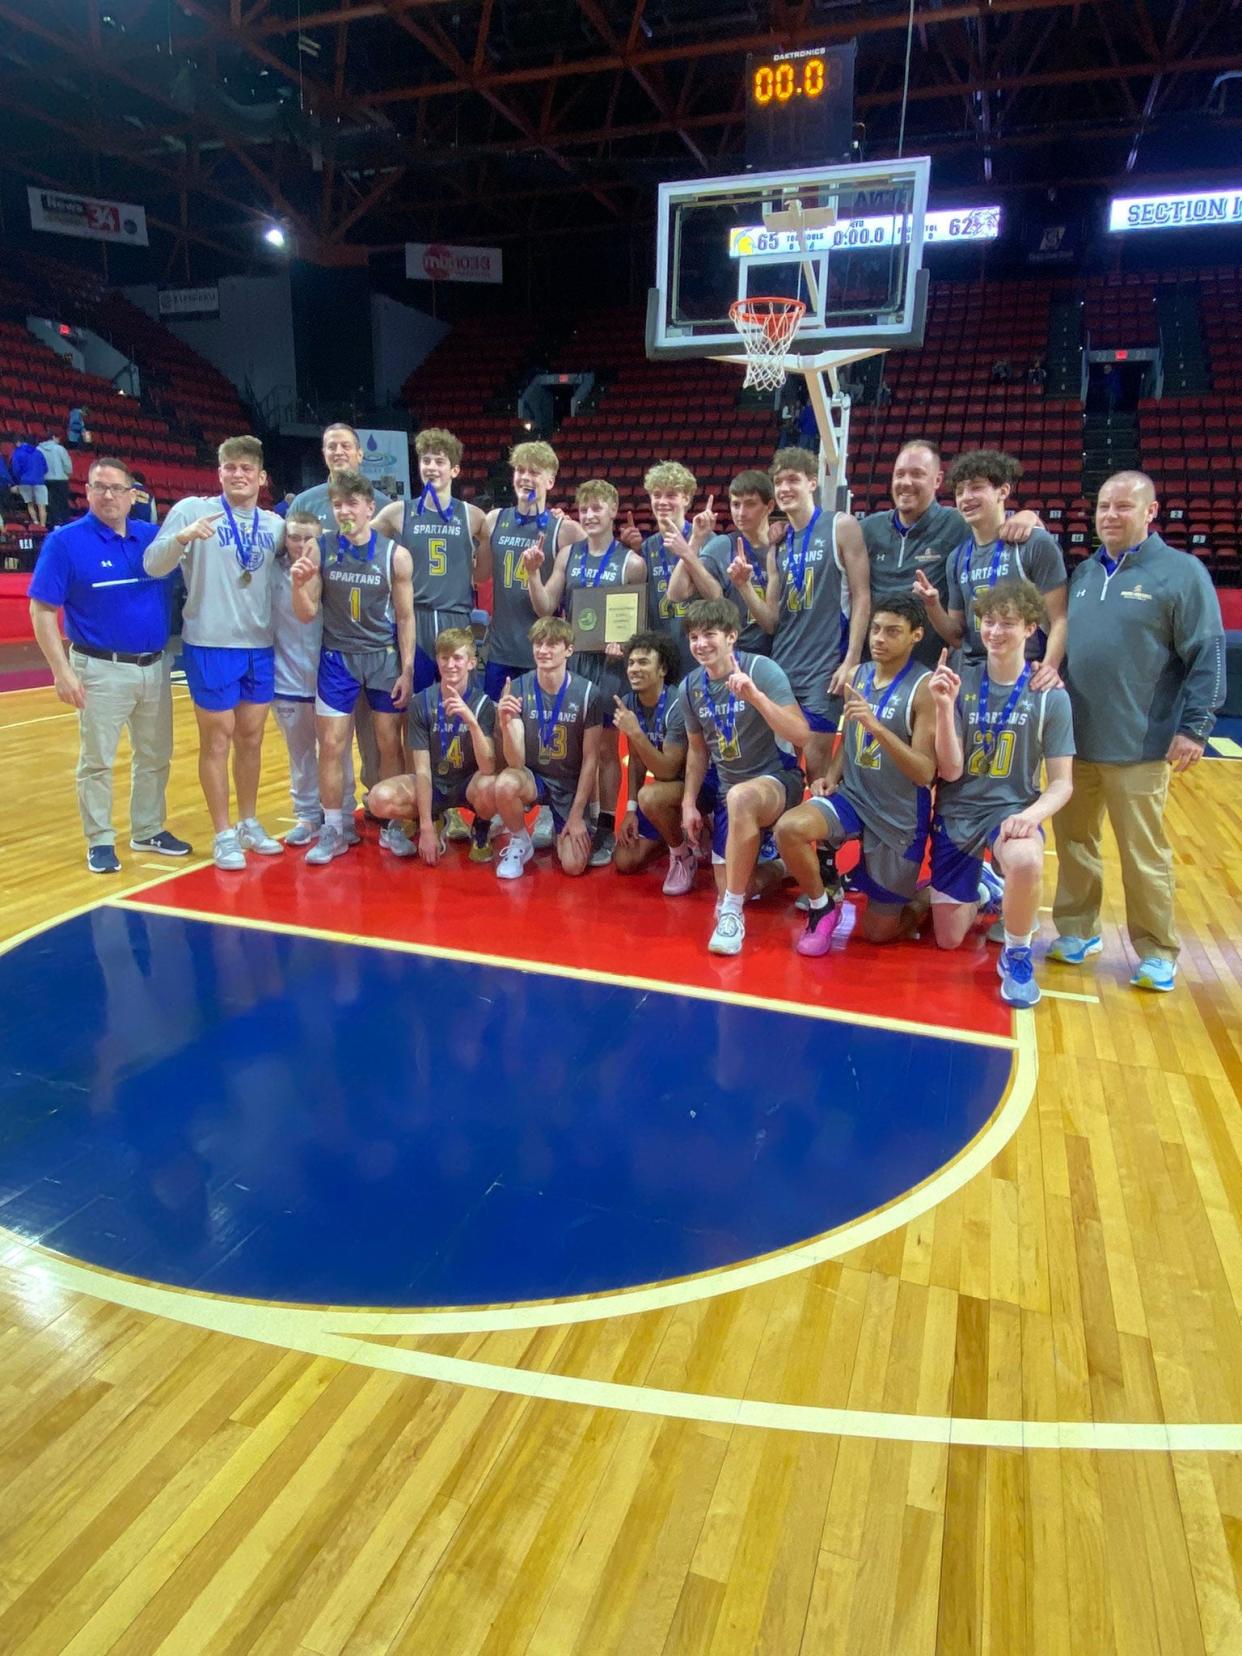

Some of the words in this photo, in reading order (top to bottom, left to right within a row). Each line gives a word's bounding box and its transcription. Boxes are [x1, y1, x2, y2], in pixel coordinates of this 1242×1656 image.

[773, 47, 826, 61] DAKTRONICS
[755, 59, 825, 102] 00.0
[1127, 197, 1227, 227] SECTION
[832, 226, 886, 248] 0:00.0
[949, 216, 973, 237] 62
[757, 231, 780, 251] 65
[413, 524, 462, 536] SPARTANS
[497, 535, 541, 549] SPARTAN
[428, 538, 448, 577] 5
[781, 549, 825, 571] SRTANS
[329, 570, 382, 585] SPARTANS
[503, 550, 530, 591] 14
[570, 566, 618, 582] SPRTNS
[960, 563, 1010, 584] SARTANS
[349, 587, 361, 623] 1
[529, 709, 577, 723] SARANS
[967, 711, 1029, 726] SARANS
[446, 735, 465, 769] 4
[967, 730, 1017, 778] 20
